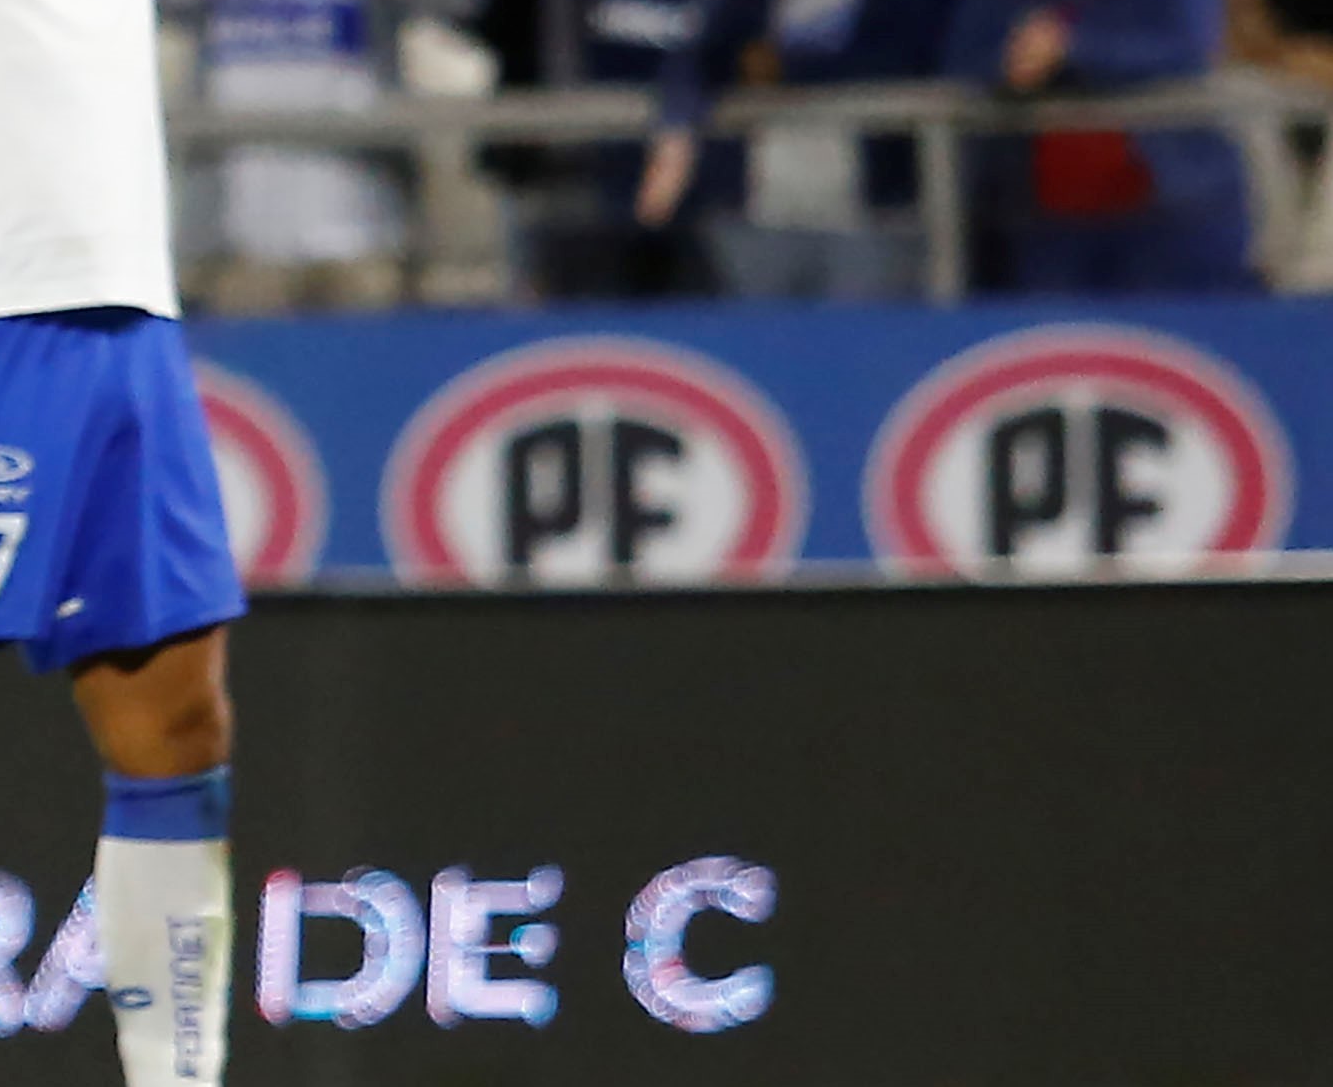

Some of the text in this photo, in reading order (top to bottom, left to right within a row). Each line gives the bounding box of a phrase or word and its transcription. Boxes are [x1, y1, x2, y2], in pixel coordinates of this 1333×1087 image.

[506, 419, 682, 581] PF
[994, 408, 1172, 563] PF
[257, 864, 563, 1030] DE
